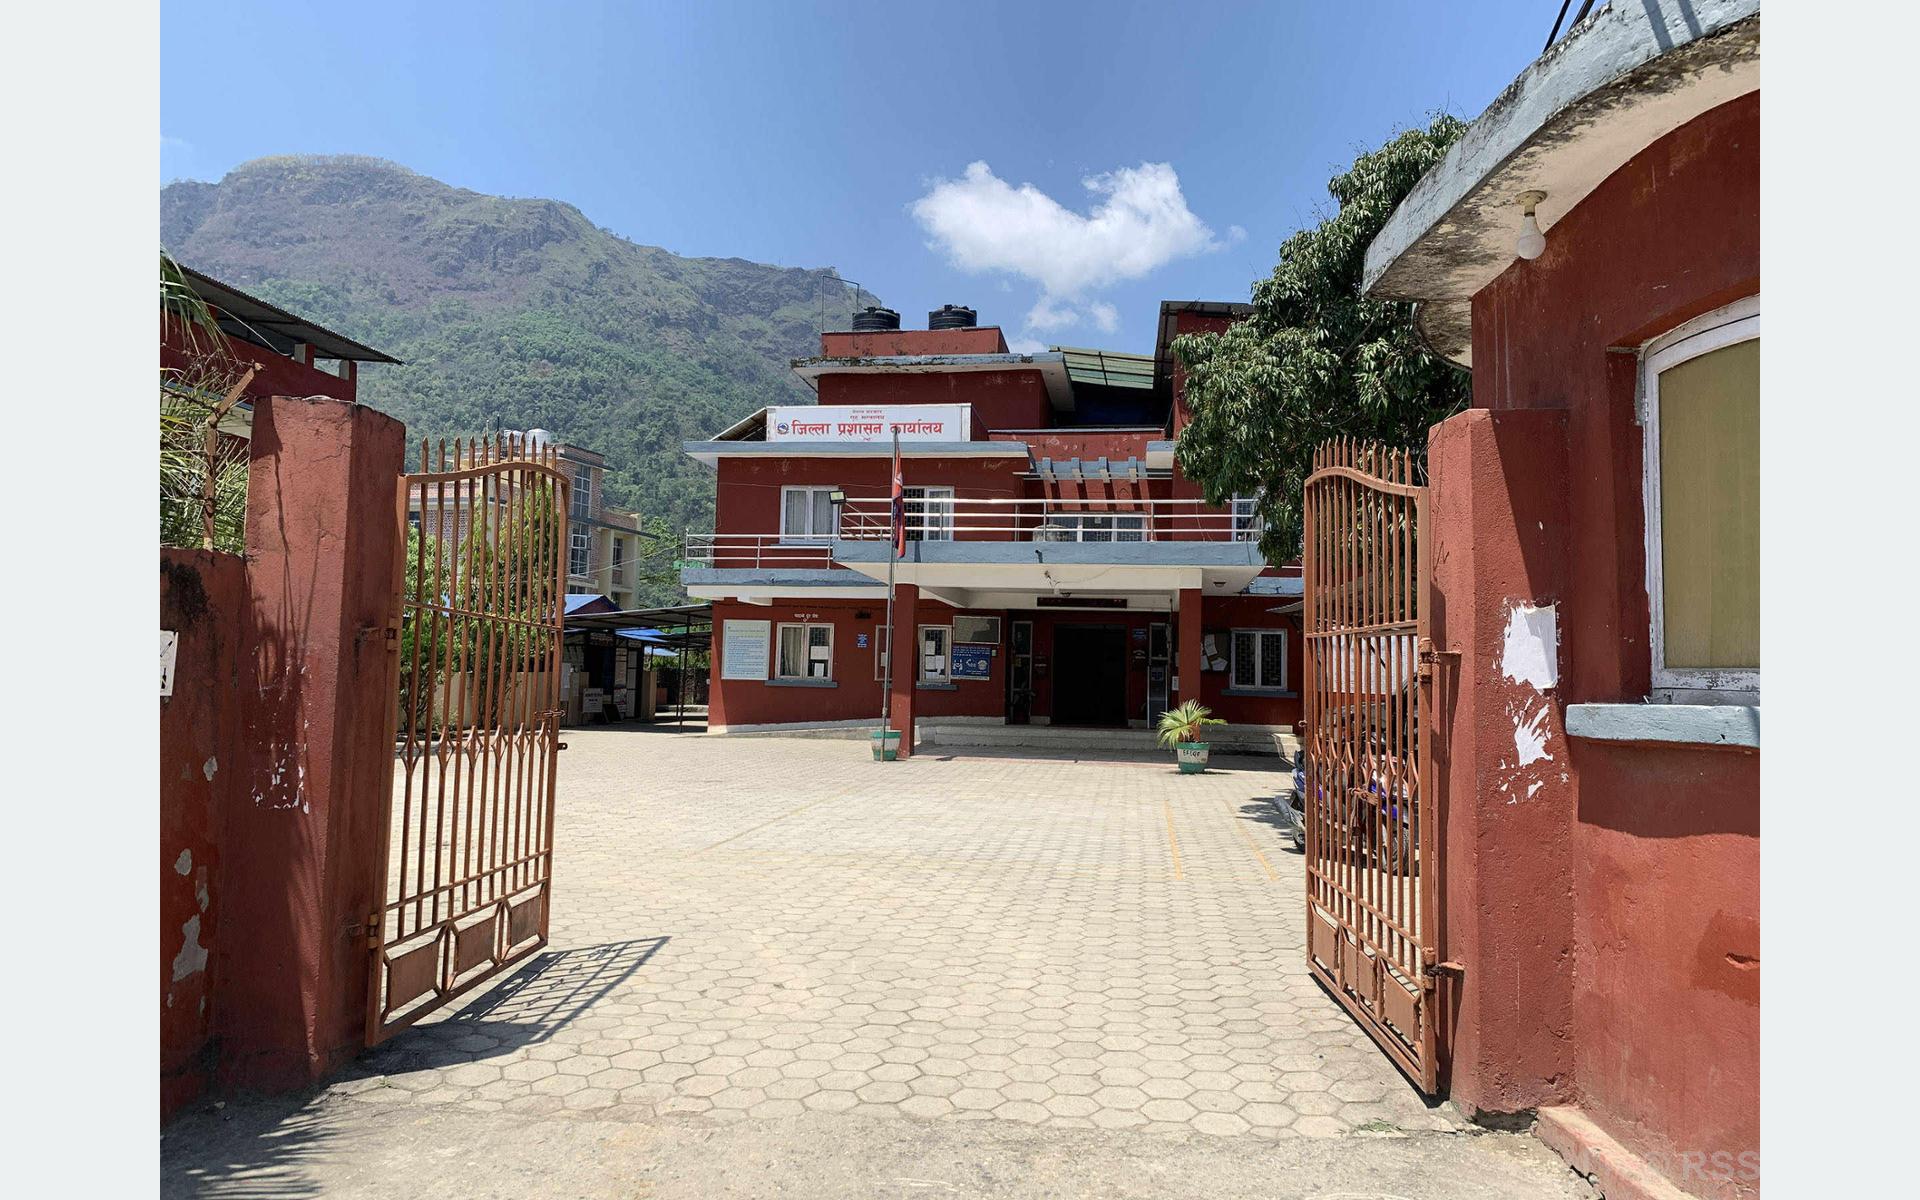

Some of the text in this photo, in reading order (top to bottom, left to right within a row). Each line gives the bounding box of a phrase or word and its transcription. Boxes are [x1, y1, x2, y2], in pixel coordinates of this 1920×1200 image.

[791, 418, 944, 436] जिल्ला प्रशासन कार्यालय
